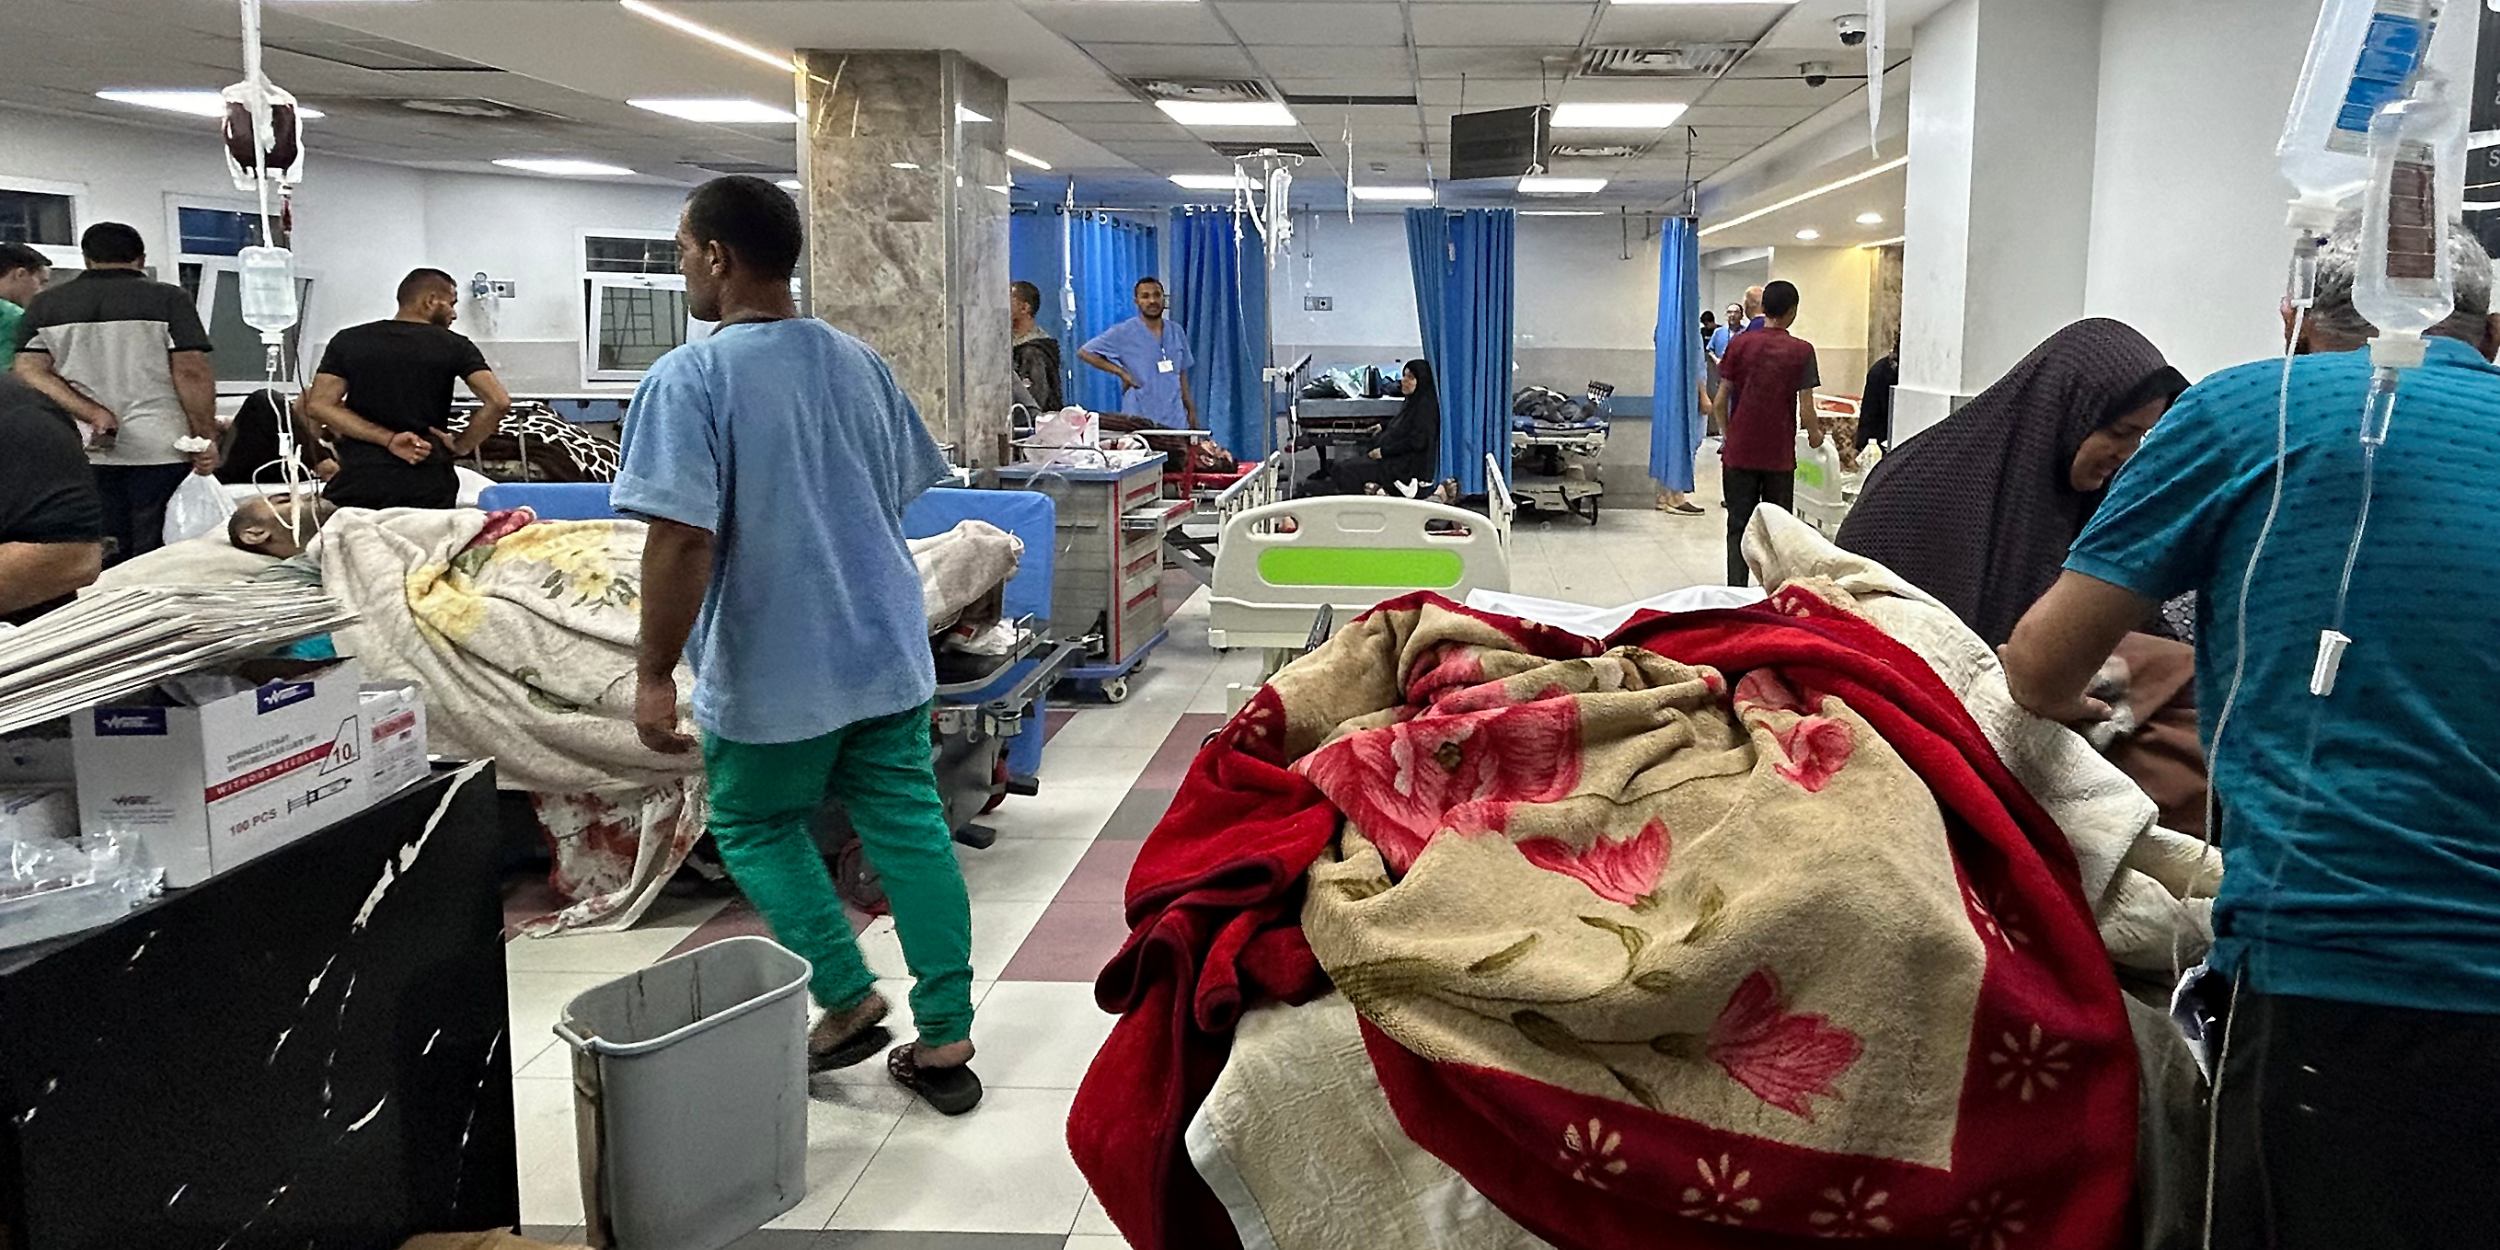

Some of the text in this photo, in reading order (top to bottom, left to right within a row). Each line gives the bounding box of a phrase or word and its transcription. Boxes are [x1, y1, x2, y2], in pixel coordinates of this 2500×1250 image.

[332, 742, 352, 764] 10
[217, 750, 316, 795] WITHOUT NEEDLE
[230, 808, 277, 836] 100 PCS
